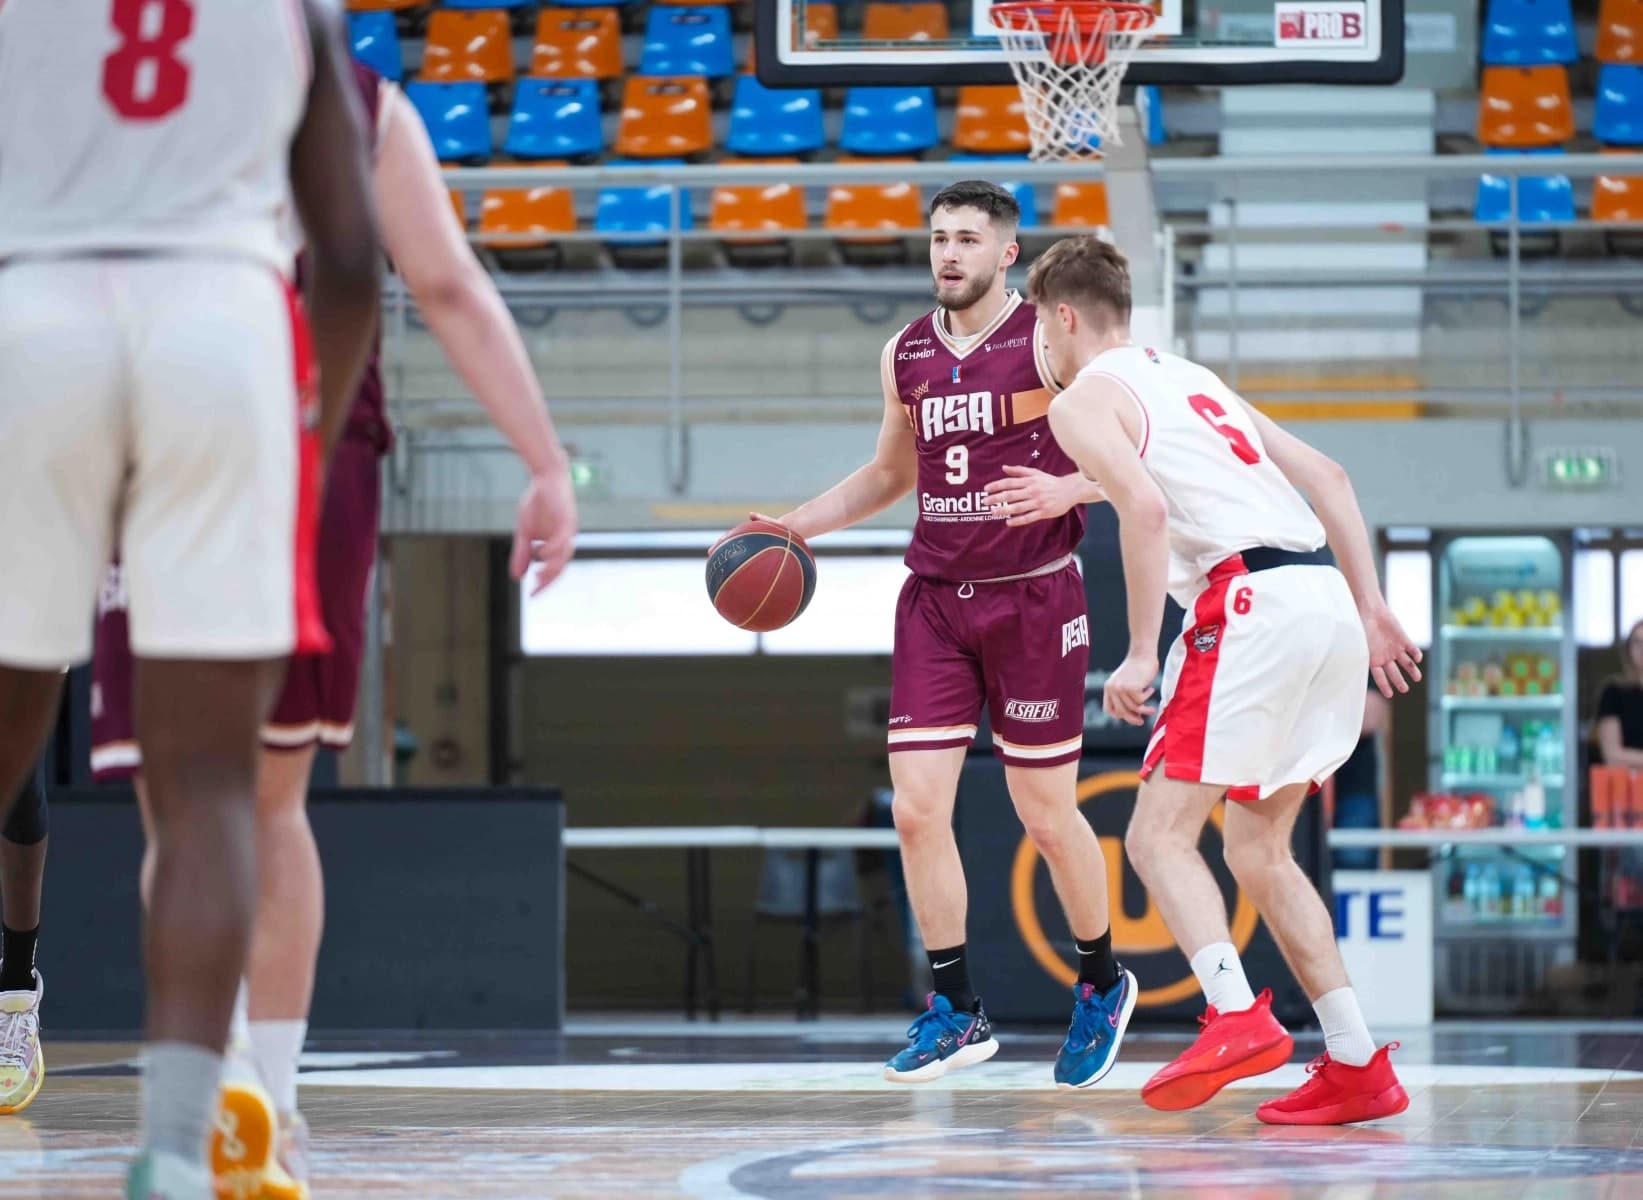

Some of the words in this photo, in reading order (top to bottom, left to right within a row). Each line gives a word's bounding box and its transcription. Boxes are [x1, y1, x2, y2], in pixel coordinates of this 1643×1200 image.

[101, 0, 195, 122] 8
[921, 391, 994, 442] ASA
[1187, 393, 1260, 465] 6
[945, 445, 969, 485] 9
[922, 492, 972, 513] Grand
[1233, 586, 1253, 615] 6
[1062, 614, 1090, 658] ASA
